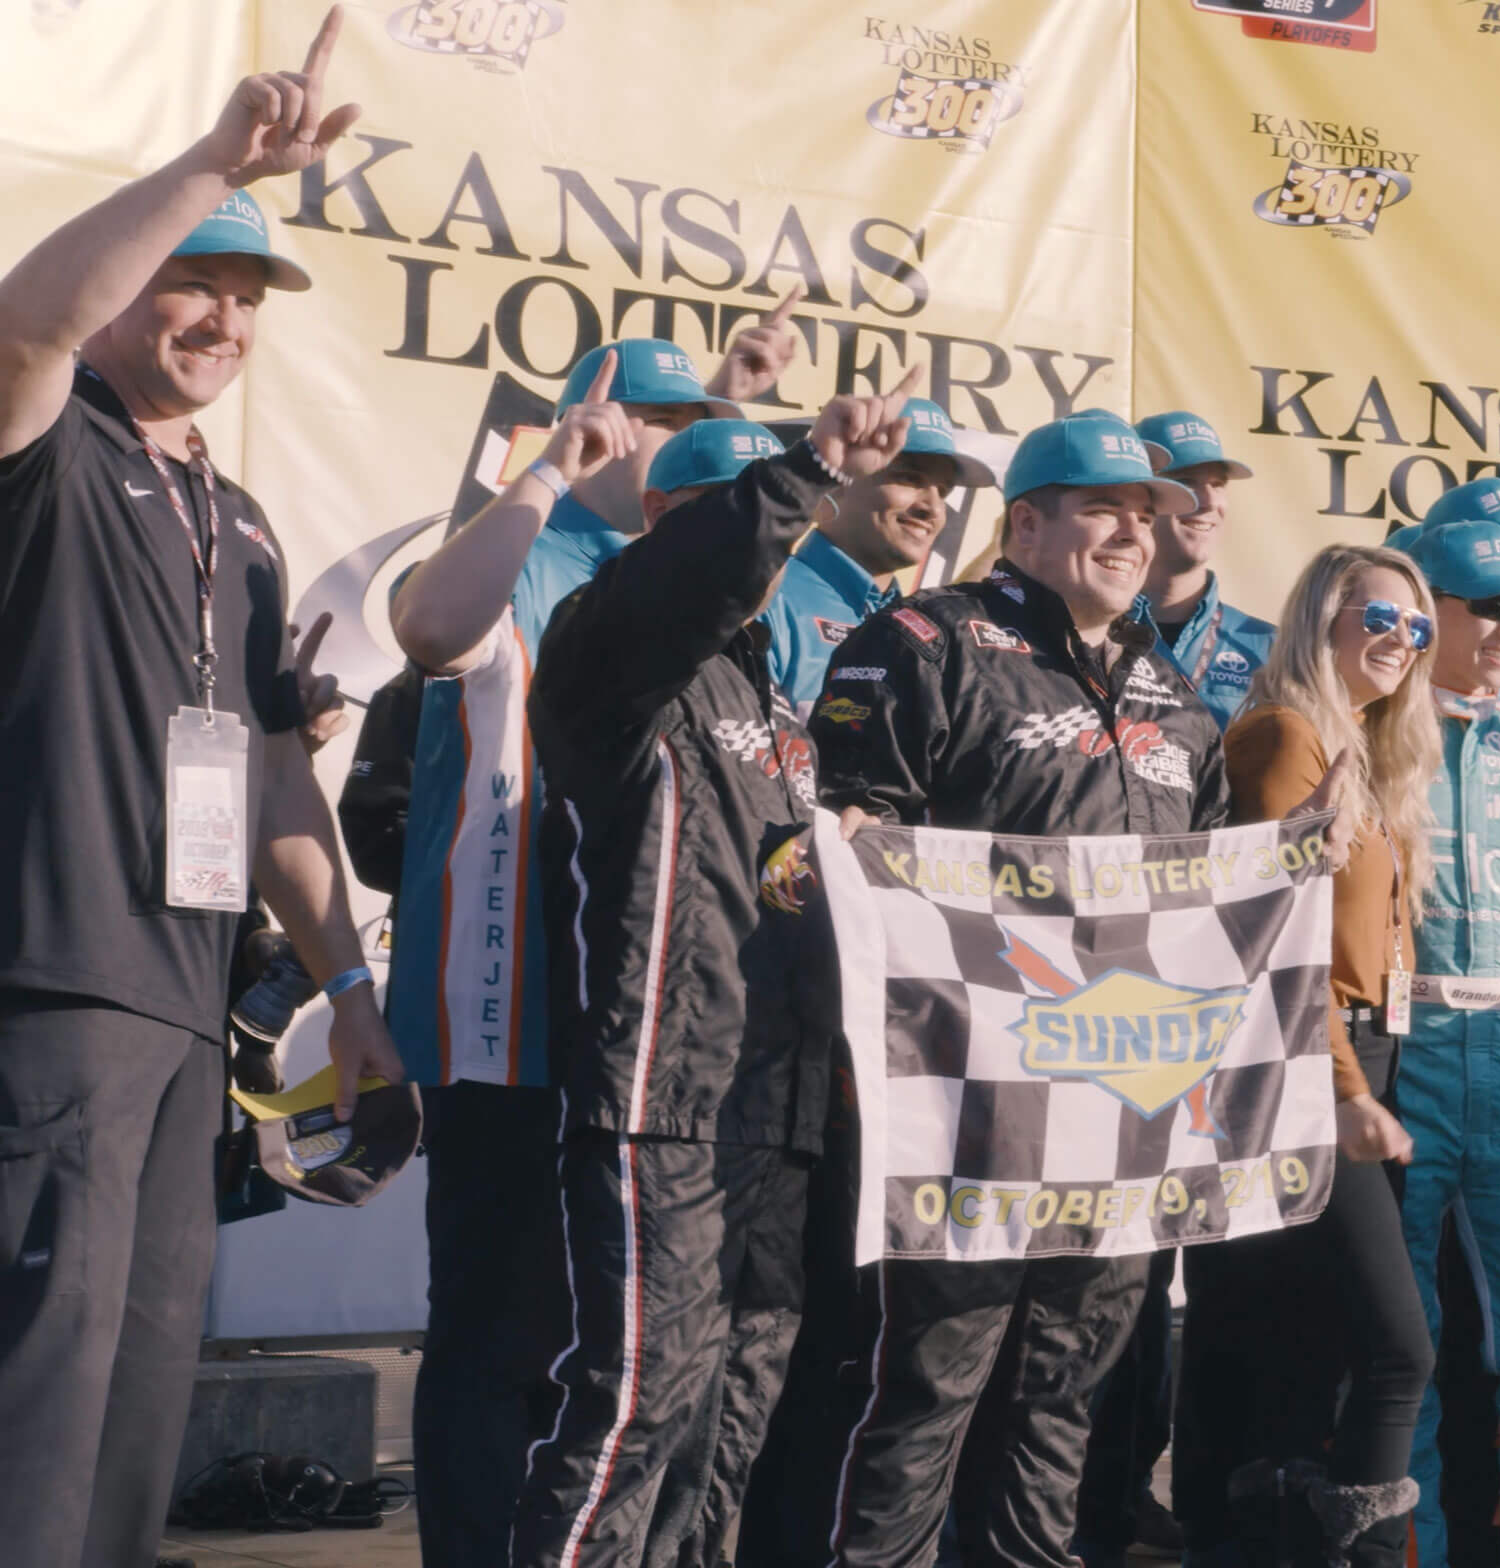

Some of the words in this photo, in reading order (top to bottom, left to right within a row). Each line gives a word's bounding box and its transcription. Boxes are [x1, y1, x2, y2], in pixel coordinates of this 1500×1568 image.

[864, 17, 992, 60] KANSAS
[1270, 22, 1353, 47] PLAYOFFS
[881, 43, 1033, 83] LOTTERY
[893, 77, 994, 137] 300
[1250, 112, 1380, 148] KANSAS
[1271, 137, 1421, 174] LOTTERY
[1279, 168, 1384, 222] 300
[281, 131, 930, 319] KANSAS
[836, 666, 888, 682] NASCAR
[883, 850, 1056, 899] KANSAS
[1068, 852, 1239, 899] LOTTERY
[480, 774, 518, 1058] WATERJET
[1033, 1003, 1238, 1064] SUNOC
